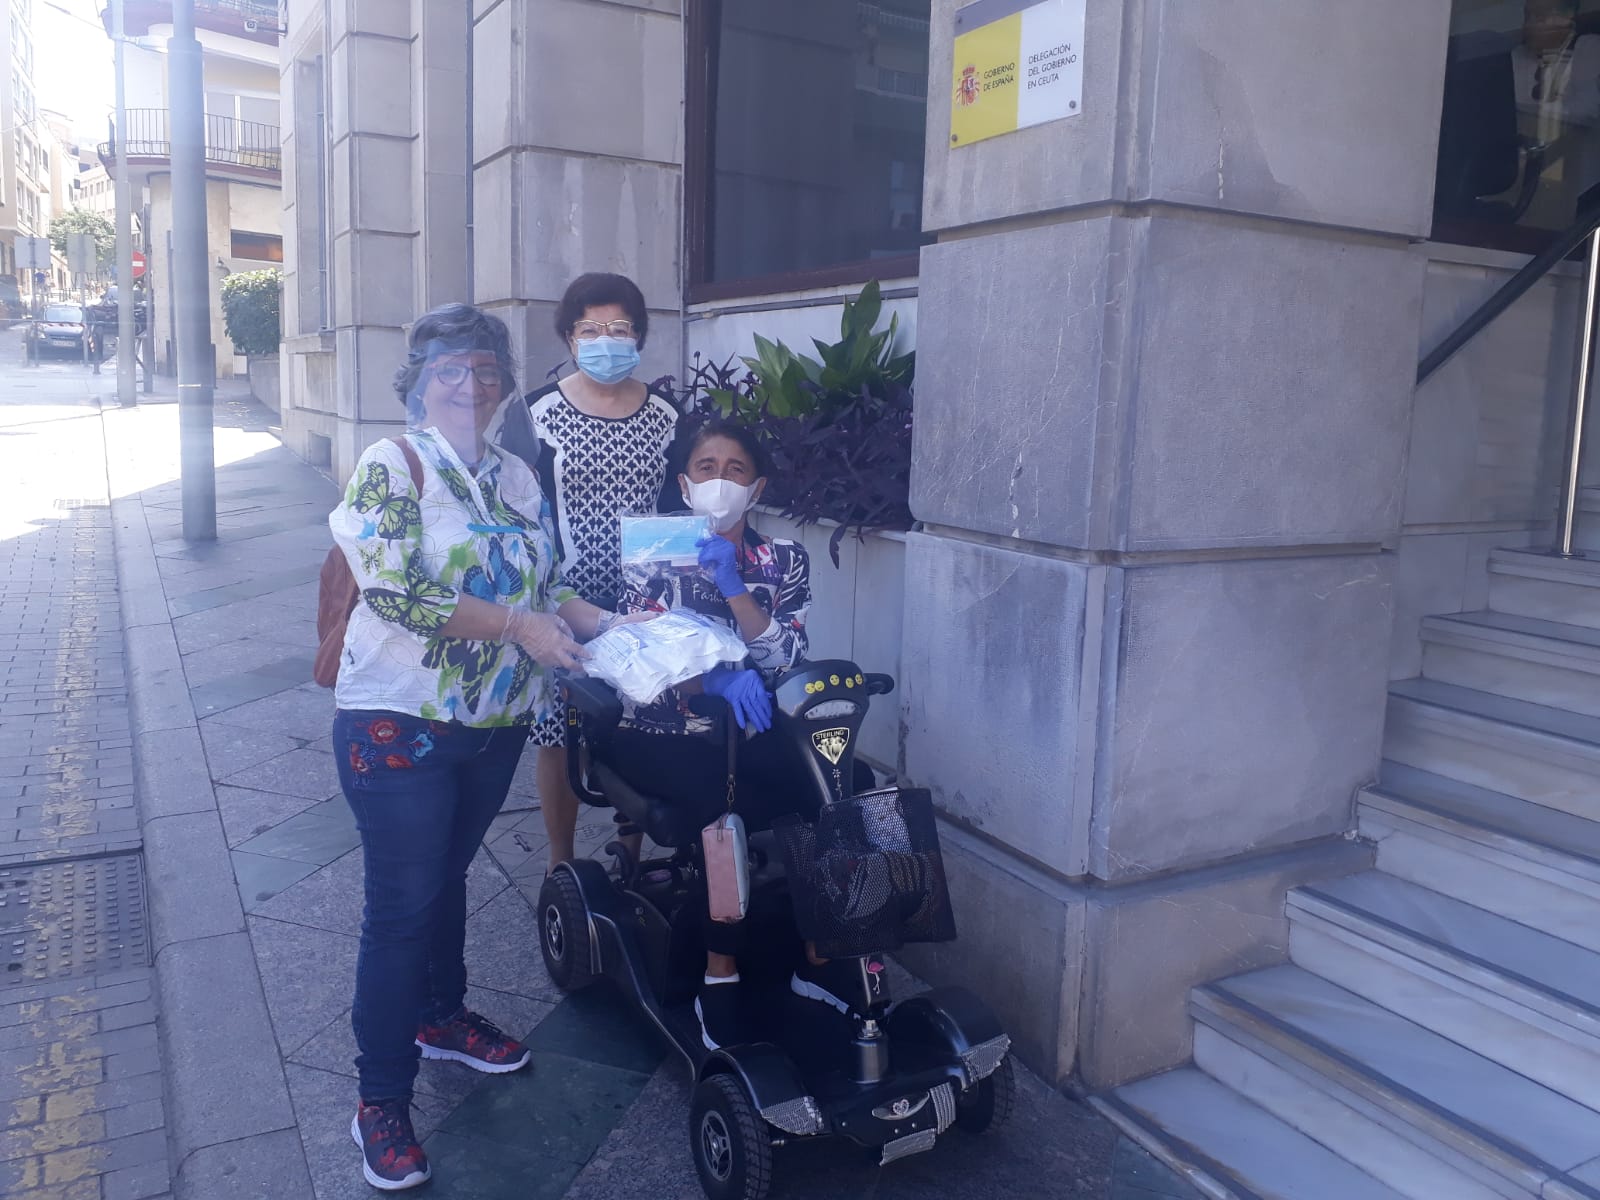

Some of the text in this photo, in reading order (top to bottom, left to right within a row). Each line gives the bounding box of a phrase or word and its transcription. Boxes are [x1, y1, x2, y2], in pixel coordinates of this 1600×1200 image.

[1028, 43, 1071, 64] DELEGACIÓN
[983, 62, 1016, 80] GOBIERNO
[1027, 54, 1077, 77] DEL GOBIERNO
[983, 74, 1014, 92] DE ESPAÑA
[1027, 72, 1059, 90] EN CEUTA
